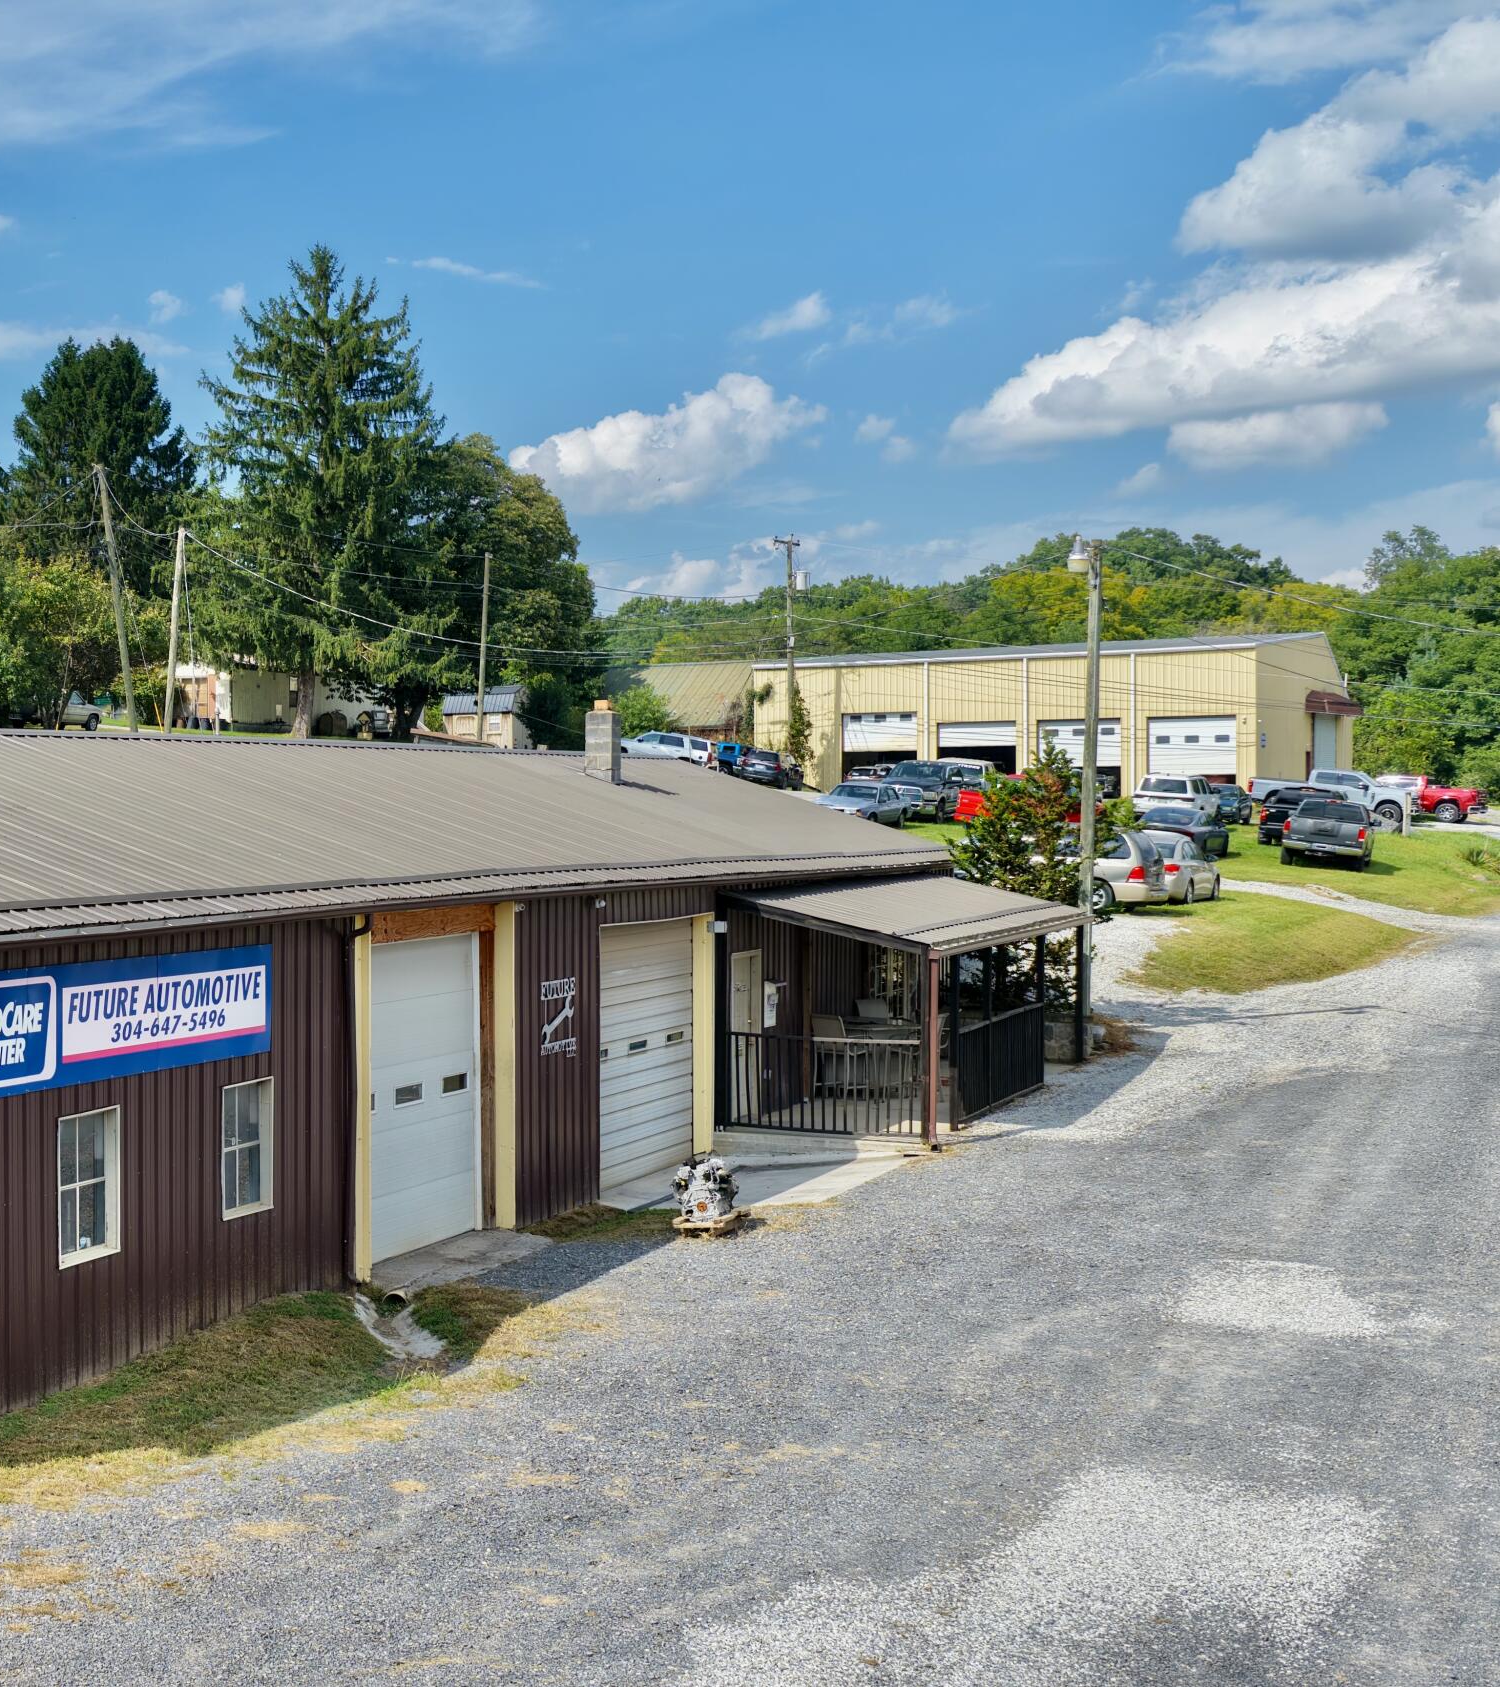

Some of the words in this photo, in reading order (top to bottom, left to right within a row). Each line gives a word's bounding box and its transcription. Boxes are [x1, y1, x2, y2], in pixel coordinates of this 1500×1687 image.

[68, 985, 140, 1024] FUTURE
[143, 971, 262, 1014] AUTOMOTIVE
[541, 977, 575, 1000] FUTURE
[111, 1009, 226, 1043] 304-647-5496
[541, 1038, 577, 1056] AUTOMOTIVE
